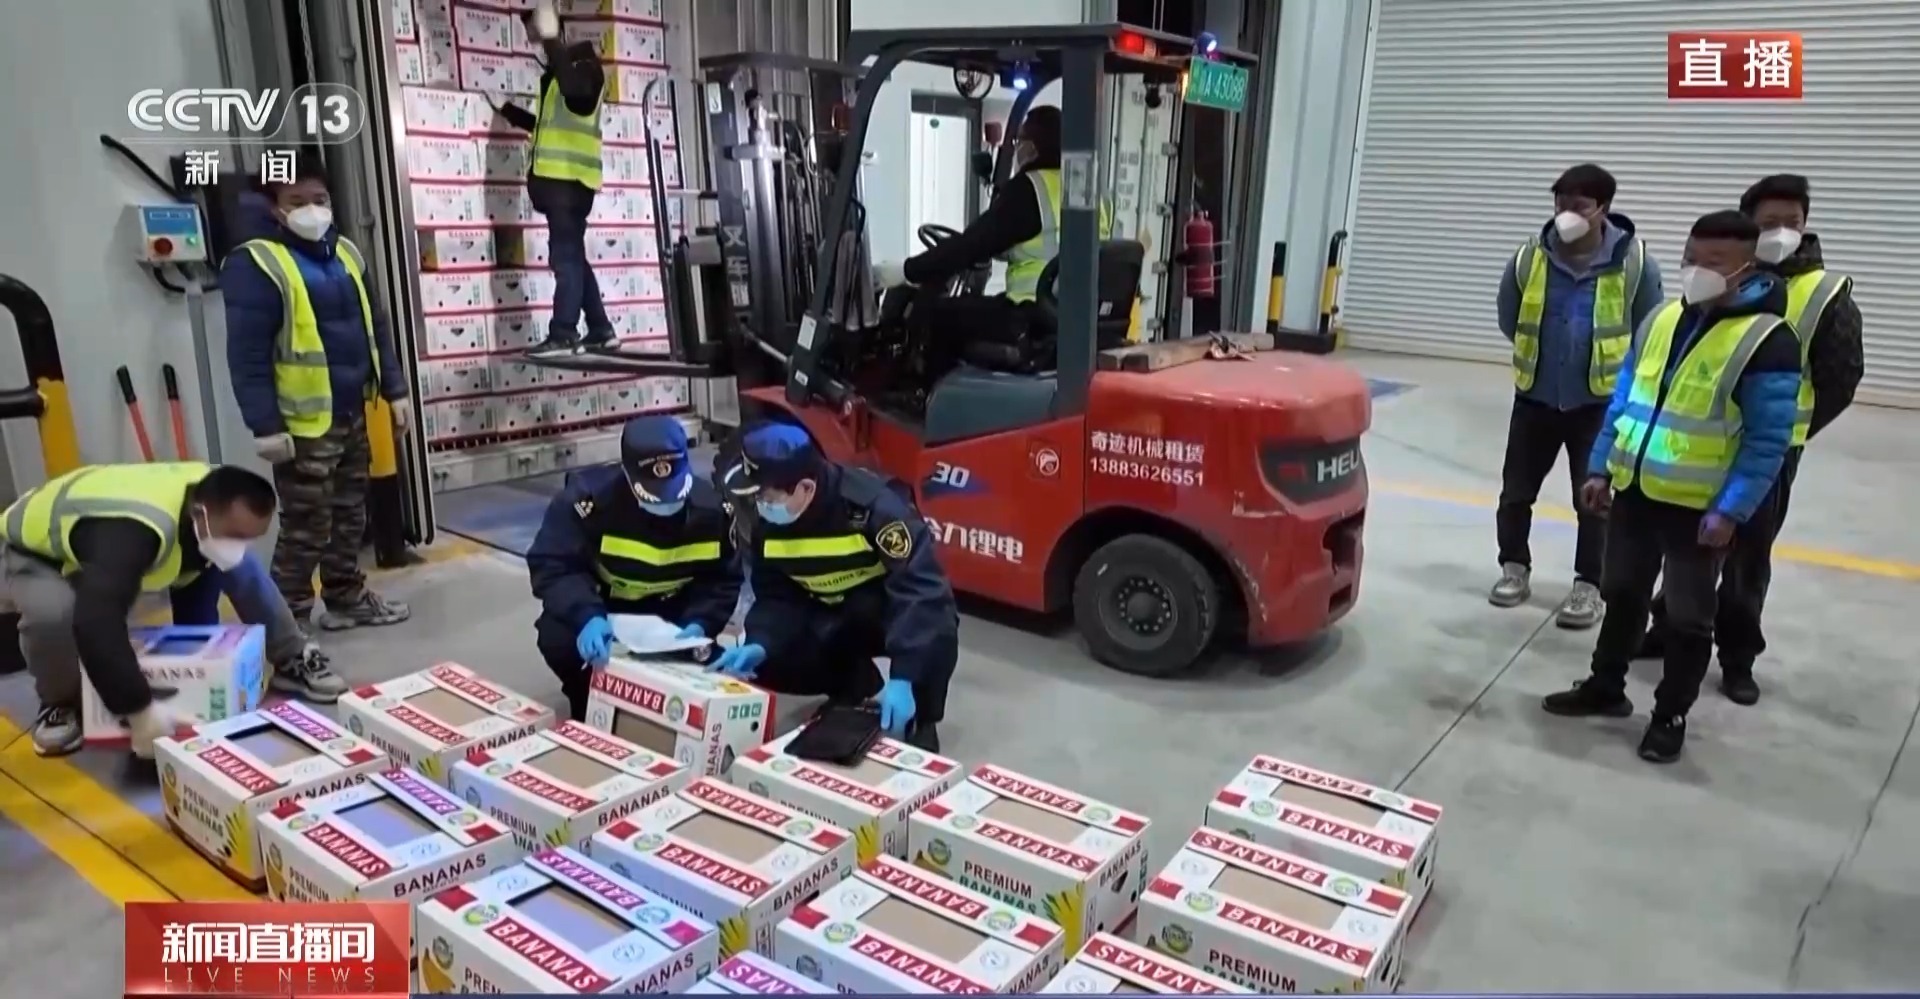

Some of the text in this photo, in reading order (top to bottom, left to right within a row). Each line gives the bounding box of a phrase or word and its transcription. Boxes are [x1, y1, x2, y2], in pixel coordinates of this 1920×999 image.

[1091, 430, 1205, 464] 奇迹机械租赁
[931, 461, 970, 489] 30
[1090, 456, 1205, 487] 13883626551
[595, 673, 662, 711] BANANAS
[466, 725, 537, 757] BANANAS
[203, 748, 274, 793] BANANAS
[507, 773, 592, 811] BANANAS
[798, 769, 889, 807] BANANAS
[982, 768, 1081, 812] BANANAS
[490, 806, 537, 837] PREMIUM
[598, 785, 670, 826] BANANAS
[691, 784, 788, 827] BANANAS
[898, 782, 949, 822] BANANAS
[307, 825, 385, 879] BANANAS
[980, 827, 1090, 870] BANANAS
[1285, 811, 1403, 857] BANANAS
[393, 854, 488, 898] BANANAS
[542, 851, 641, 909] BANANAS
[660, 845, 762, 899] BANANAS
[964, 860, 1033, 899] PREMIUM
[1200, 835, 1321, 882] BANANAS
[289, 866, 330, 902] PREMIUM
[773, 858, 840, 912] BANANAS
[870, 866, 984, 918] BANANAS
[492, 920, 598, 992] BANANAS
[1226, 905, 1359, 963] BANANAS
[860, 937, 981, 994] BANANAS
[1096, 945, 1217, 994] ANANAS
[1209, 949, 1296, 994] PREMIUM
